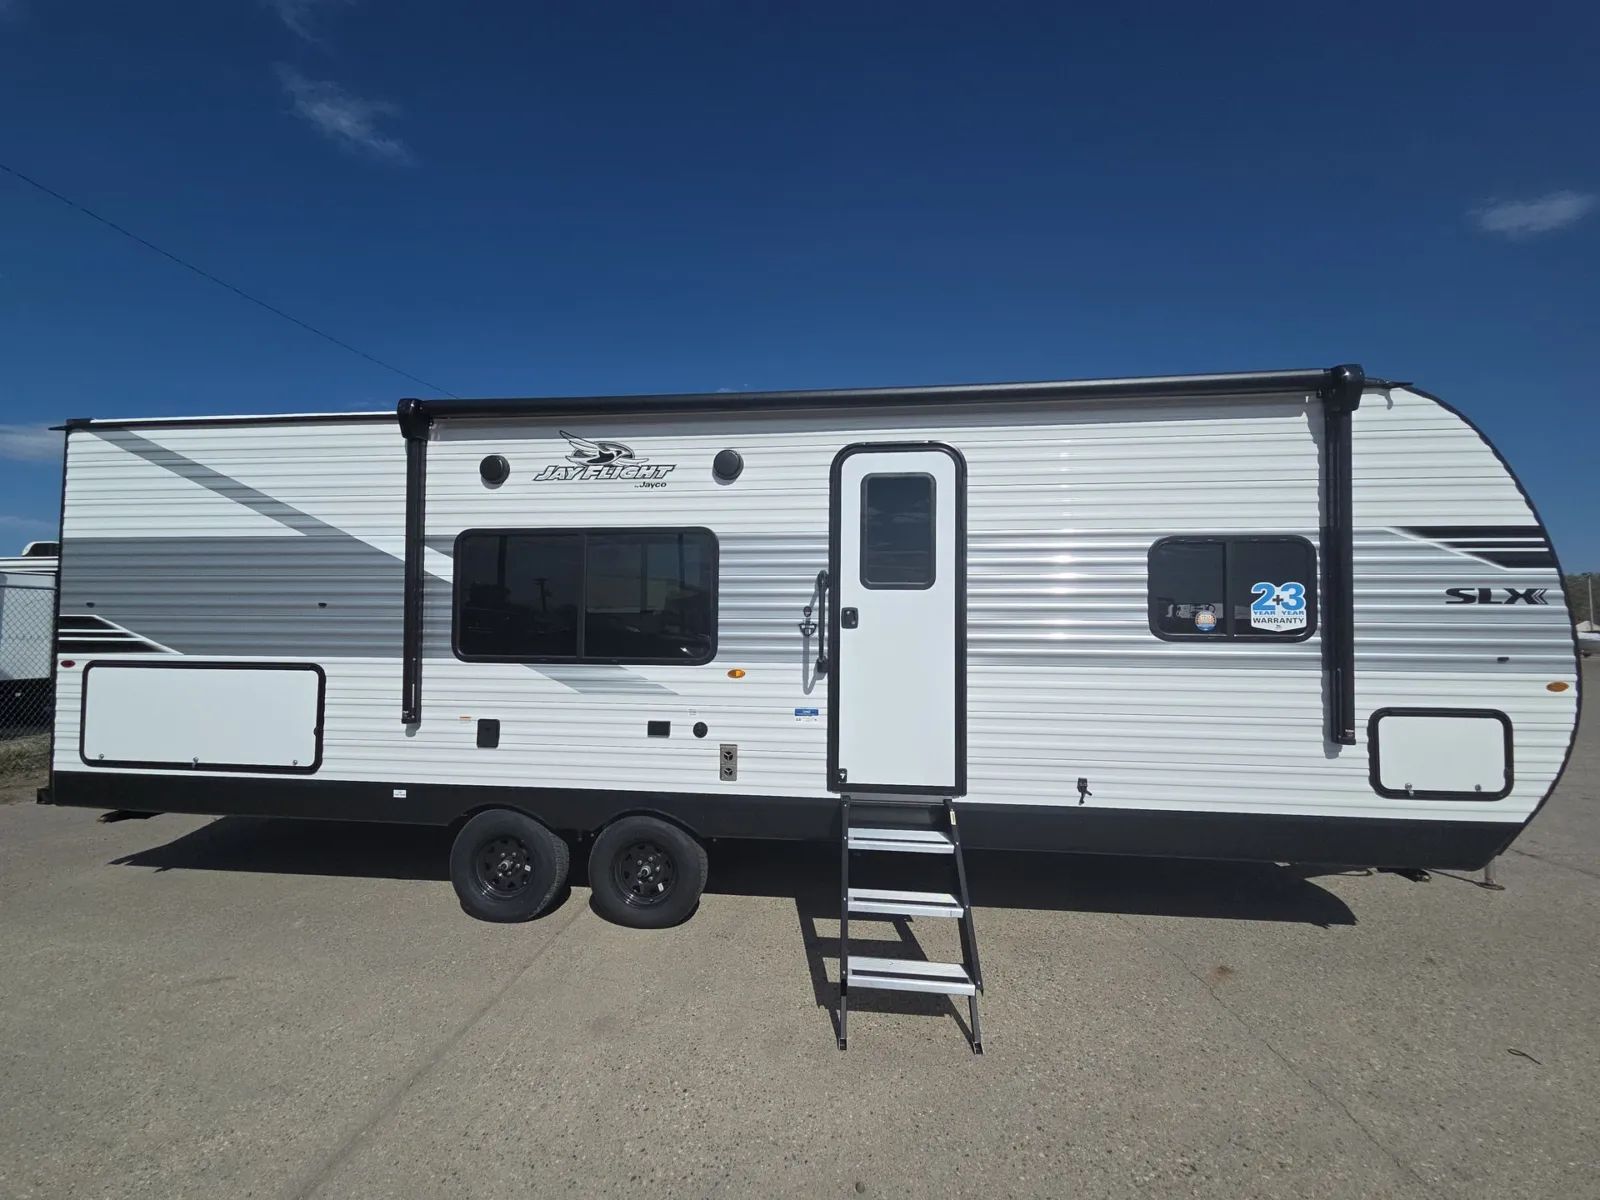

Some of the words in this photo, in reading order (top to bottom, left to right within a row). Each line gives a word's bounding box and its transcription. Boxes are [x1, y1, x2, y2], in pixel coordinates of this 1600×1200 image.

[533, 465, 585, 481] JAY
[579, 464, 677, 480] FLIGHT
[1445, 588, 1549, 605] SLX
